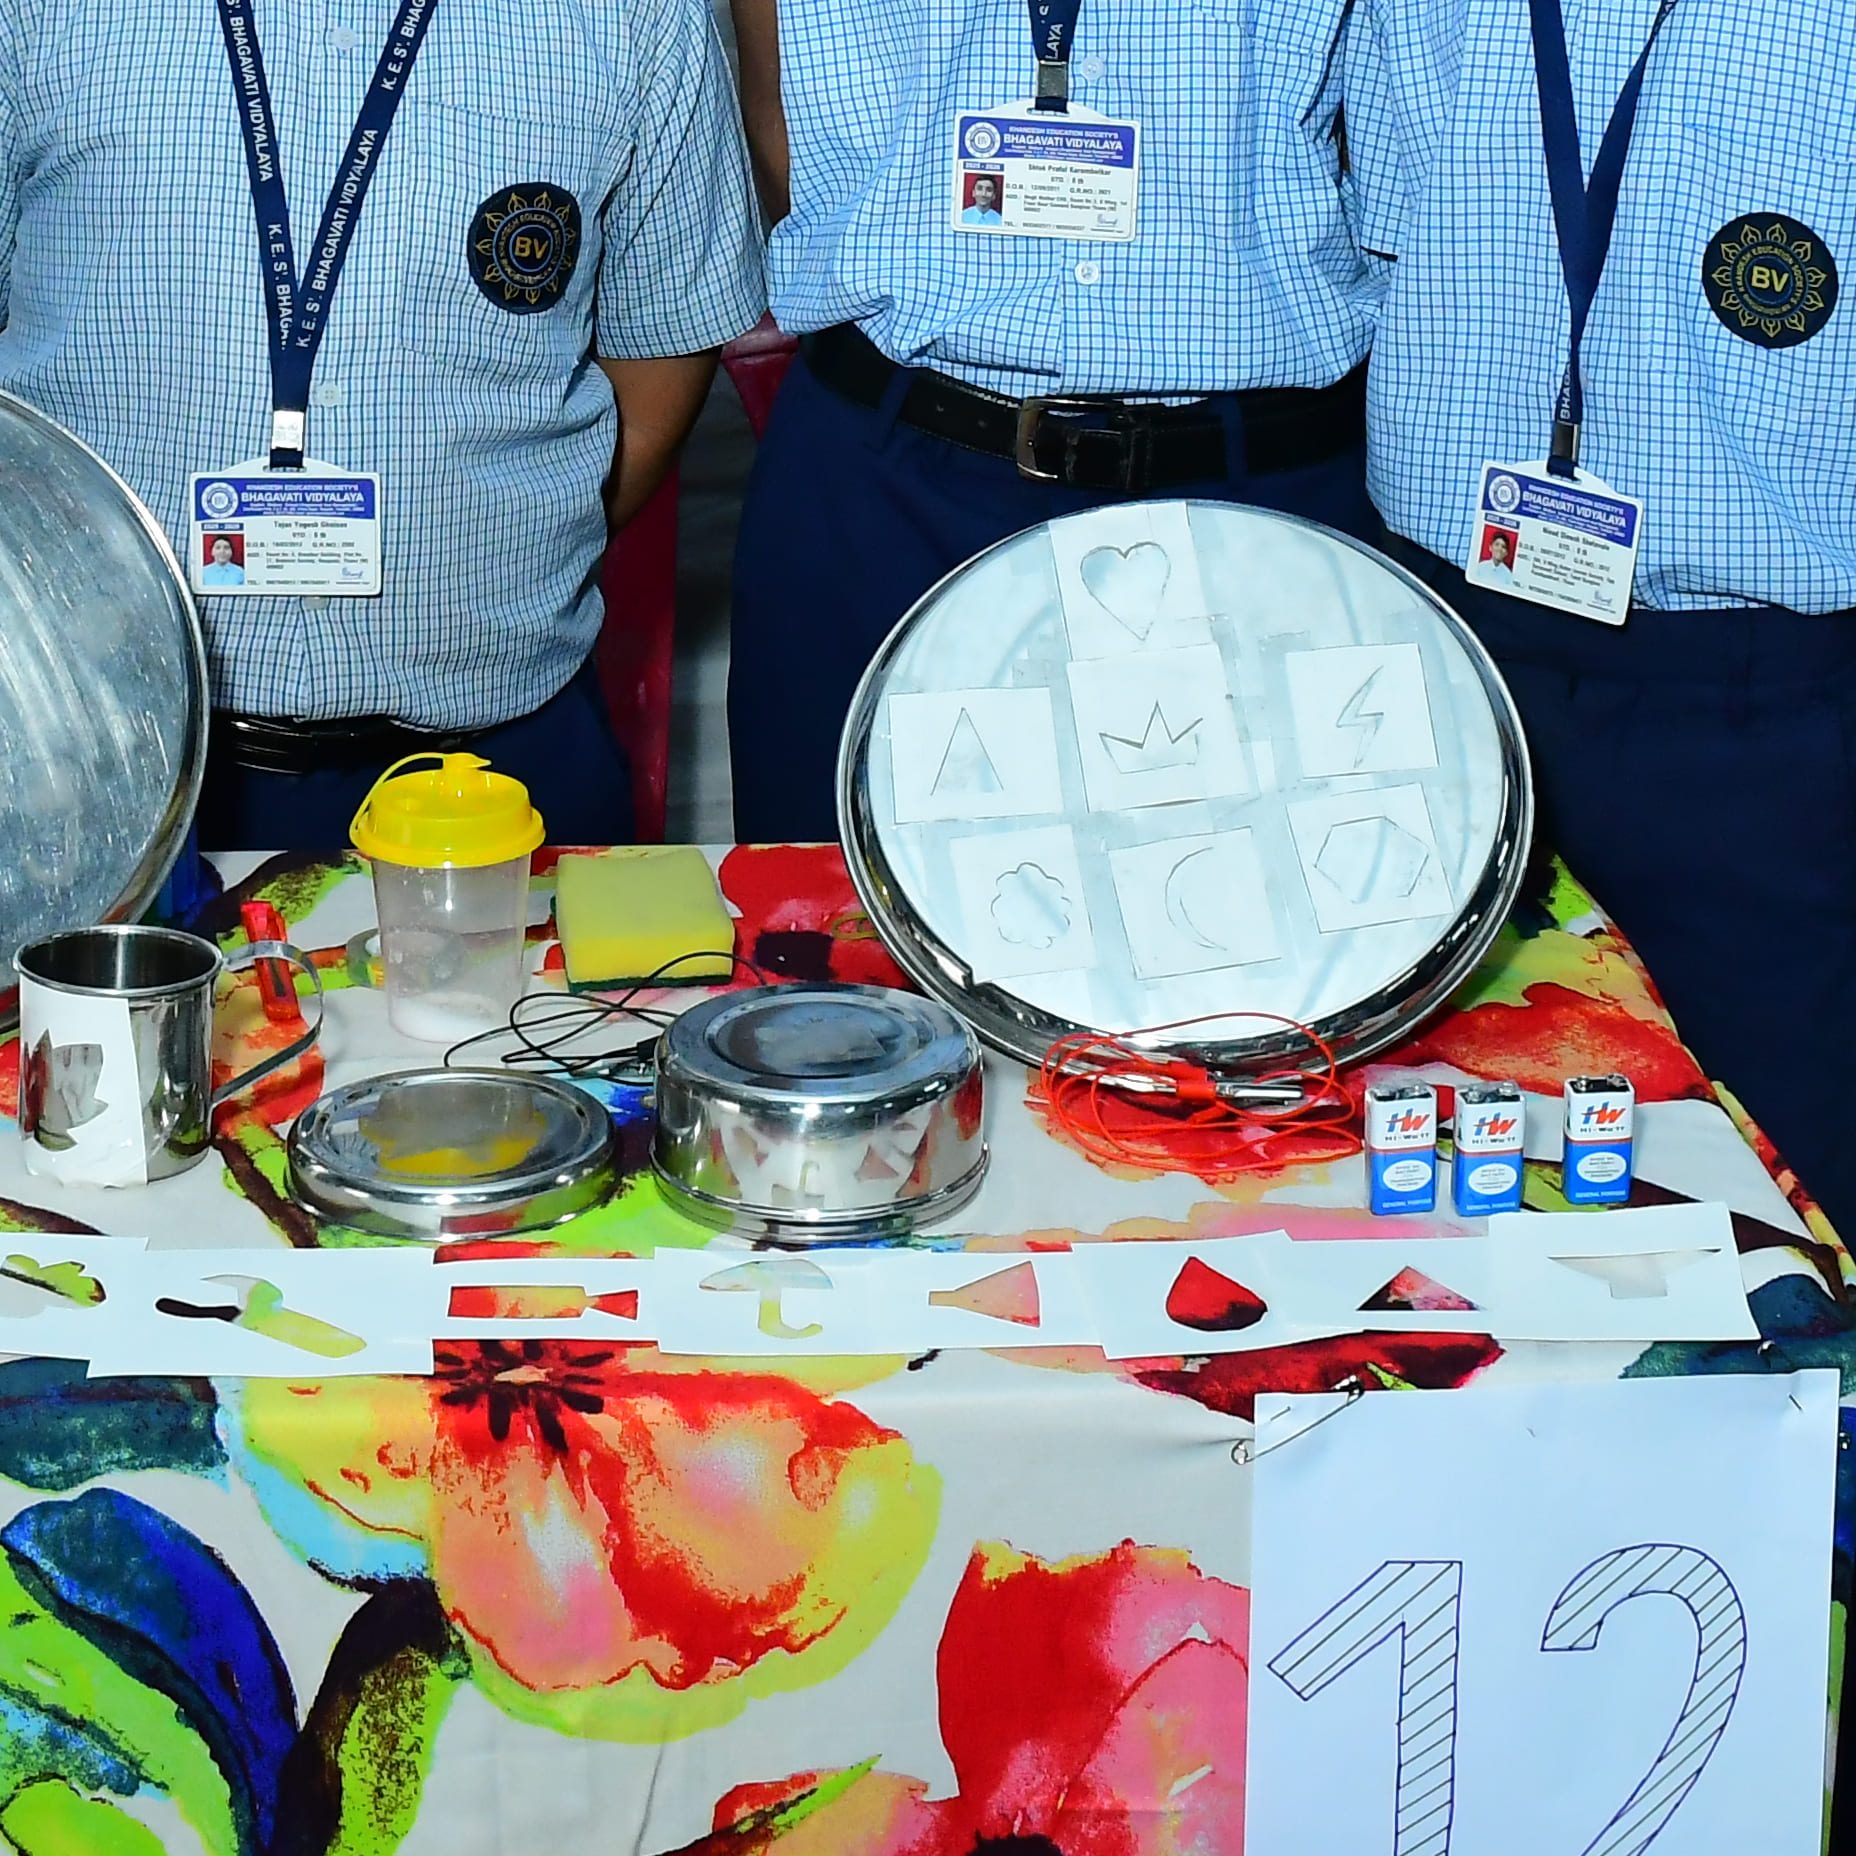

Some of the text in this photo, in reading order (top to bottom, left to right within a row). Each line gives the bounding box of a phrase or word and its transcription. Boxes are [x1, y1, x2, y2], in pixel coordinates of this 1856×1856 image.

[229, 15, 274, 183] BHAGAVATI VIDYALAYA
[1003, 134, 1124, 152] BHAGAVATI VIDYALAYA
[311, 128, 379, 292] BHAGAVATI VIDYALAYA
[514, 236, 549, 259] BV
[1751, 265, 1789, 293] BV
[241, 491, 365, 503] BHAGAVATI VIDYALAYA
[1267, 1541, 1748, 1856] 12
